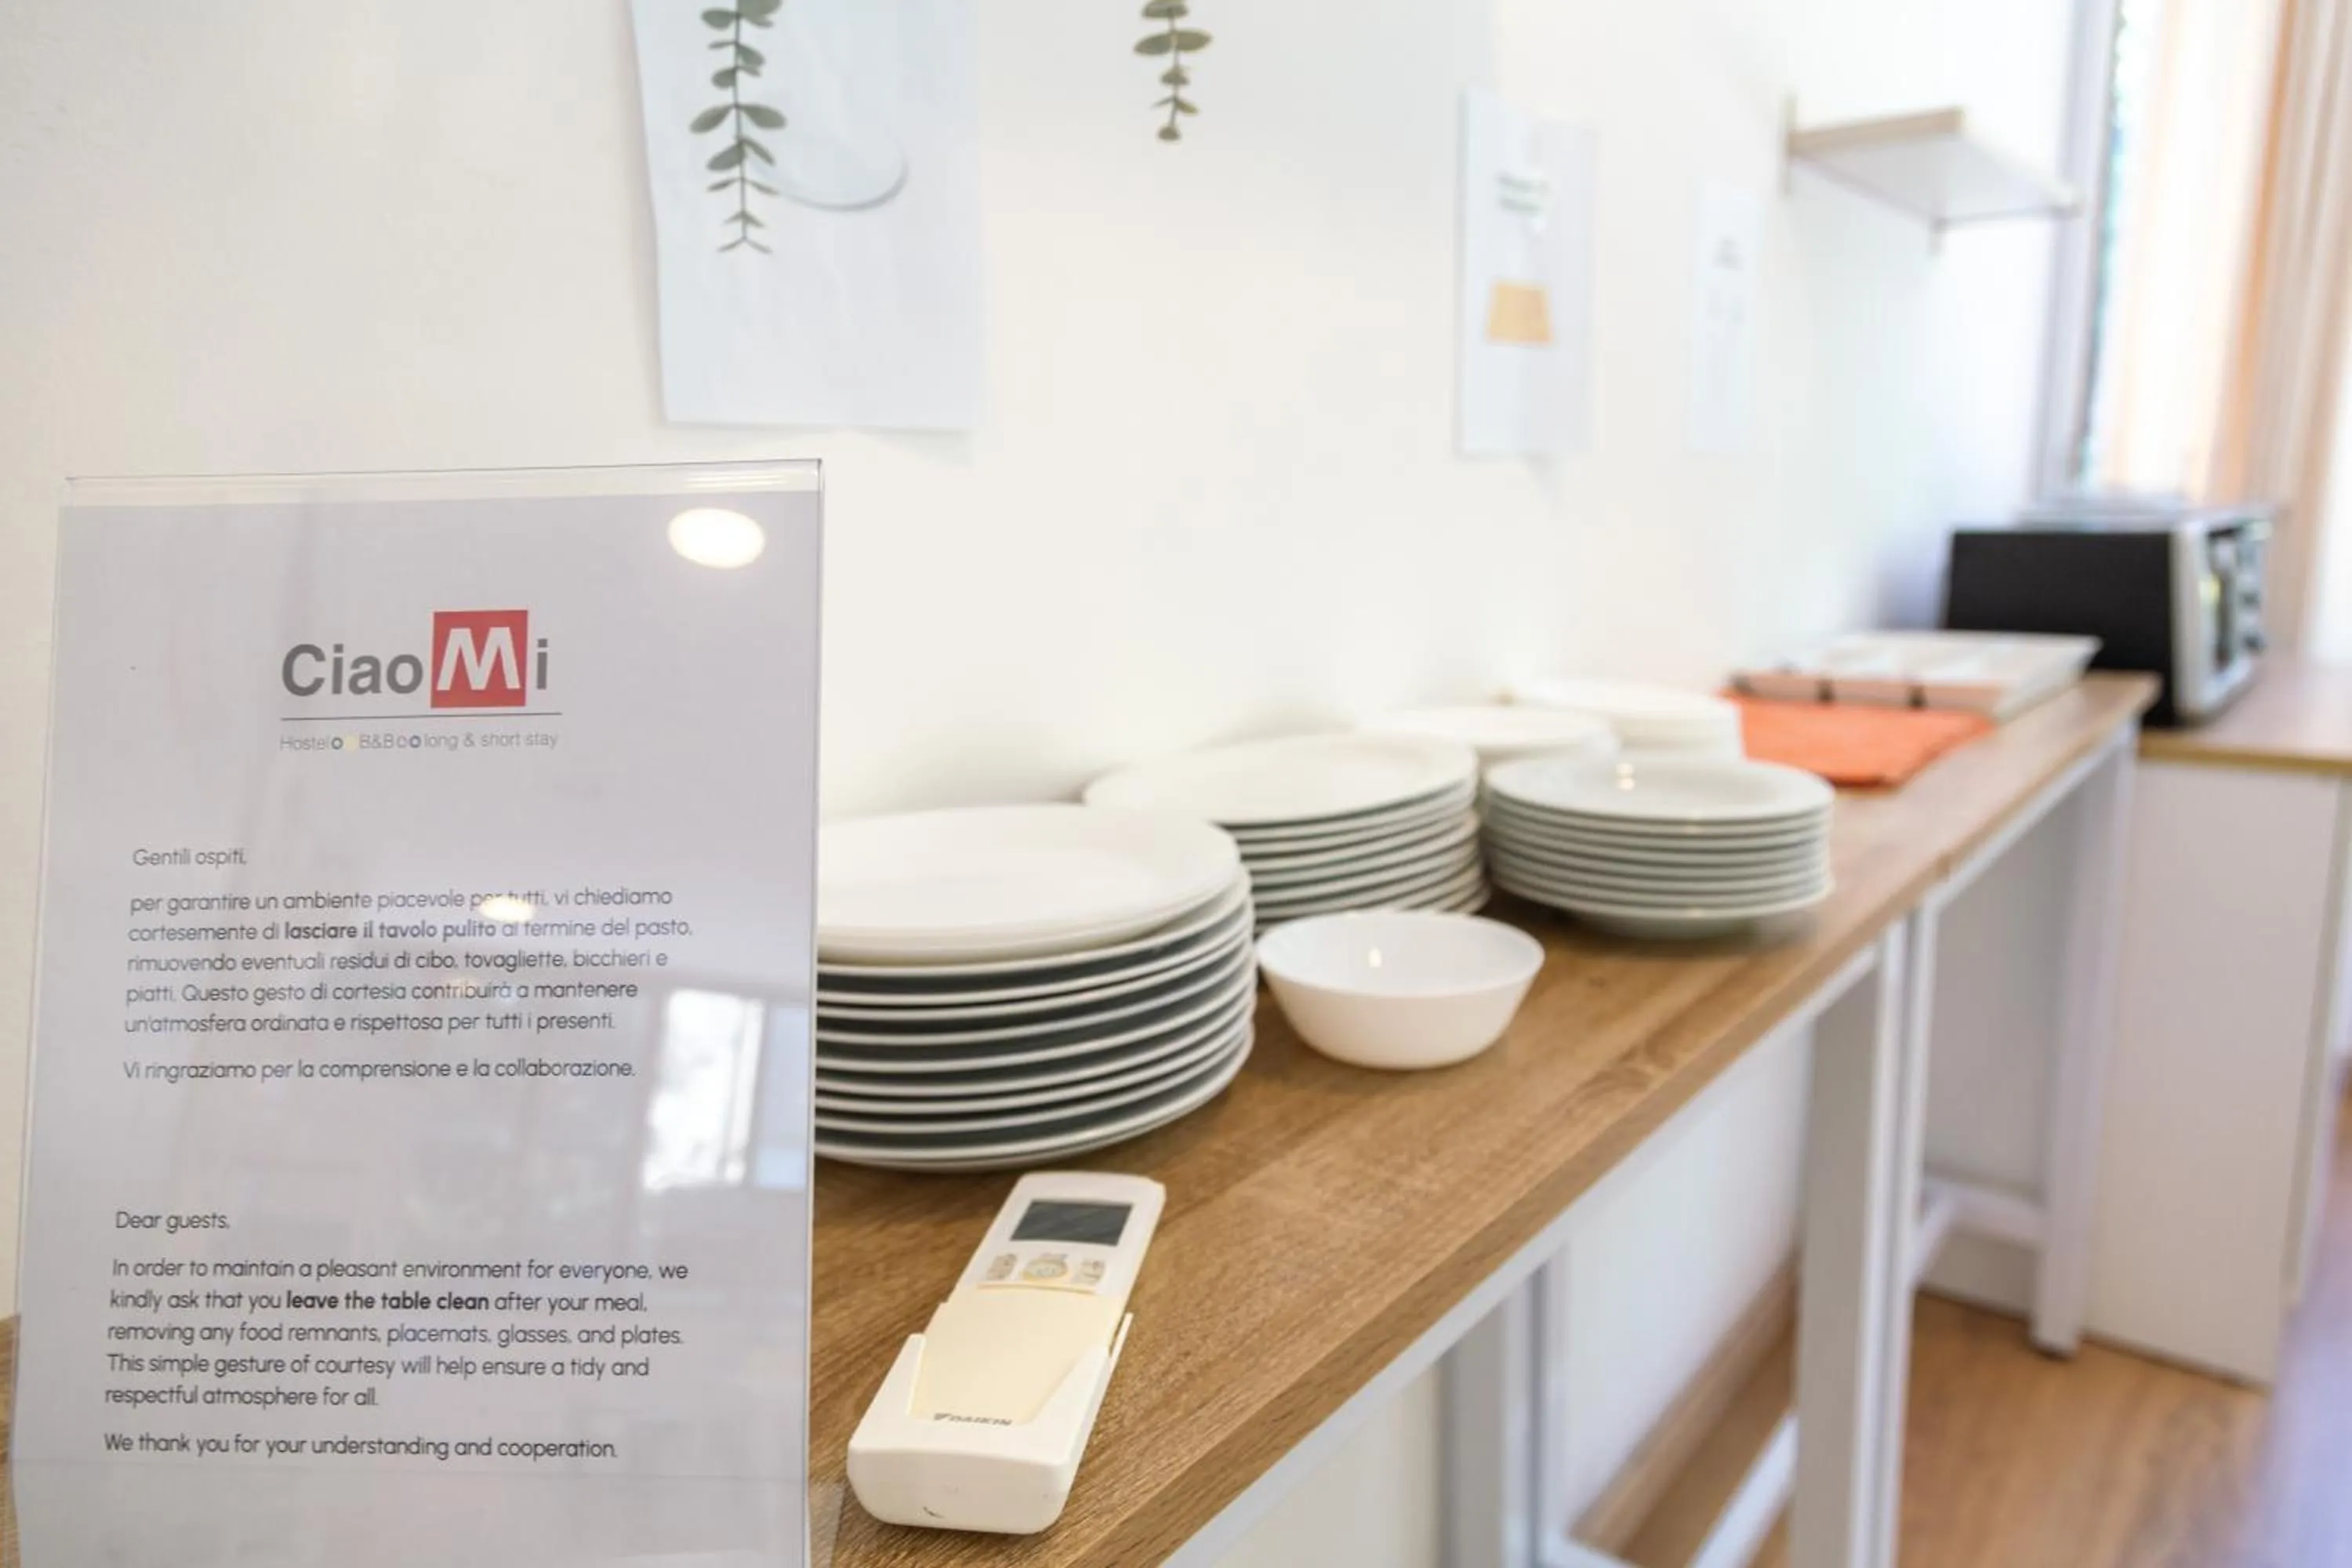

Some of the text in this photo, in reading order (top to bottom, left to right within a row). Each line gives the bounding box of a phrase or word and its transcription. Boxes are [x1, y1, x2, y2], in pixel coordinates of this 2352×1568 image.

[424, 732, 459, 751] long
[463, 731, 475, 748] &
[481, 731, 521, 747] short
[525, 730, 559, 750] stay
[132, 848, 247, 869] Gentili ospiti,
[130, 898, 163, 916] per
[167, 894, 251, 916] garantire
[256, 896, 278, 909] un
[283, 891, 372, 909] ambiente
[378, 889, 465, 912] piacevole
[554, 890, 568, 906] vi
[574, 887, 673, 906] chiediamo
[128, 917, 692, 942] cortesemente di lasciare il tavolo pulito al termine del pasto,
[128, 949, 668, 973] rimuovendo eventuali residui di cibo, tovagliette, bicchieri e
[126, 986, 176, 1007] piatti.
[182, 985, 249, 1001] Questo
[253, 985, 306, 1006] gesto
[310, 982, 327, 1000] di
[332, 985, 406, 1000] cortesia
[517, 985, 528, 998] a
[535, 982, 637, 998] mantenere
[125, 1013, 246, 1033] un'atmosfera
[251, 1015, 328, 1032] ordinata
[334, 1018, 346, 1031] e
[350, 1014, 443, 1035] rispettosa
[448, 1017, 480, 1034] per
[485, 1013, 522, 1029] tutti
[537, 1013, 615, 1034] presenti.
[123, 1058, 635, 1083] Vi ringraziamo per la comprensione e la collaborazione.
[116, 1211, 230, 1234] Dear guests,
[113, 1258, 688, 1284] In order to maintain a pleasant environment for everyone, we
[110, 1290, 647, 1316] kindly ask that you leave the table clean after your meal,
[107, 1321, 683, 1348] removing any food remnants, placemats, glasses, and plates.
[107, 1353, 649, 1381] This simple gesture of courtesy will help ensure a tidy and
[105, 1385, 378, 1410] respectful atmosphere for all.
[104, 1432, 616, 1461] We thank you for your understanding and cooperation.
